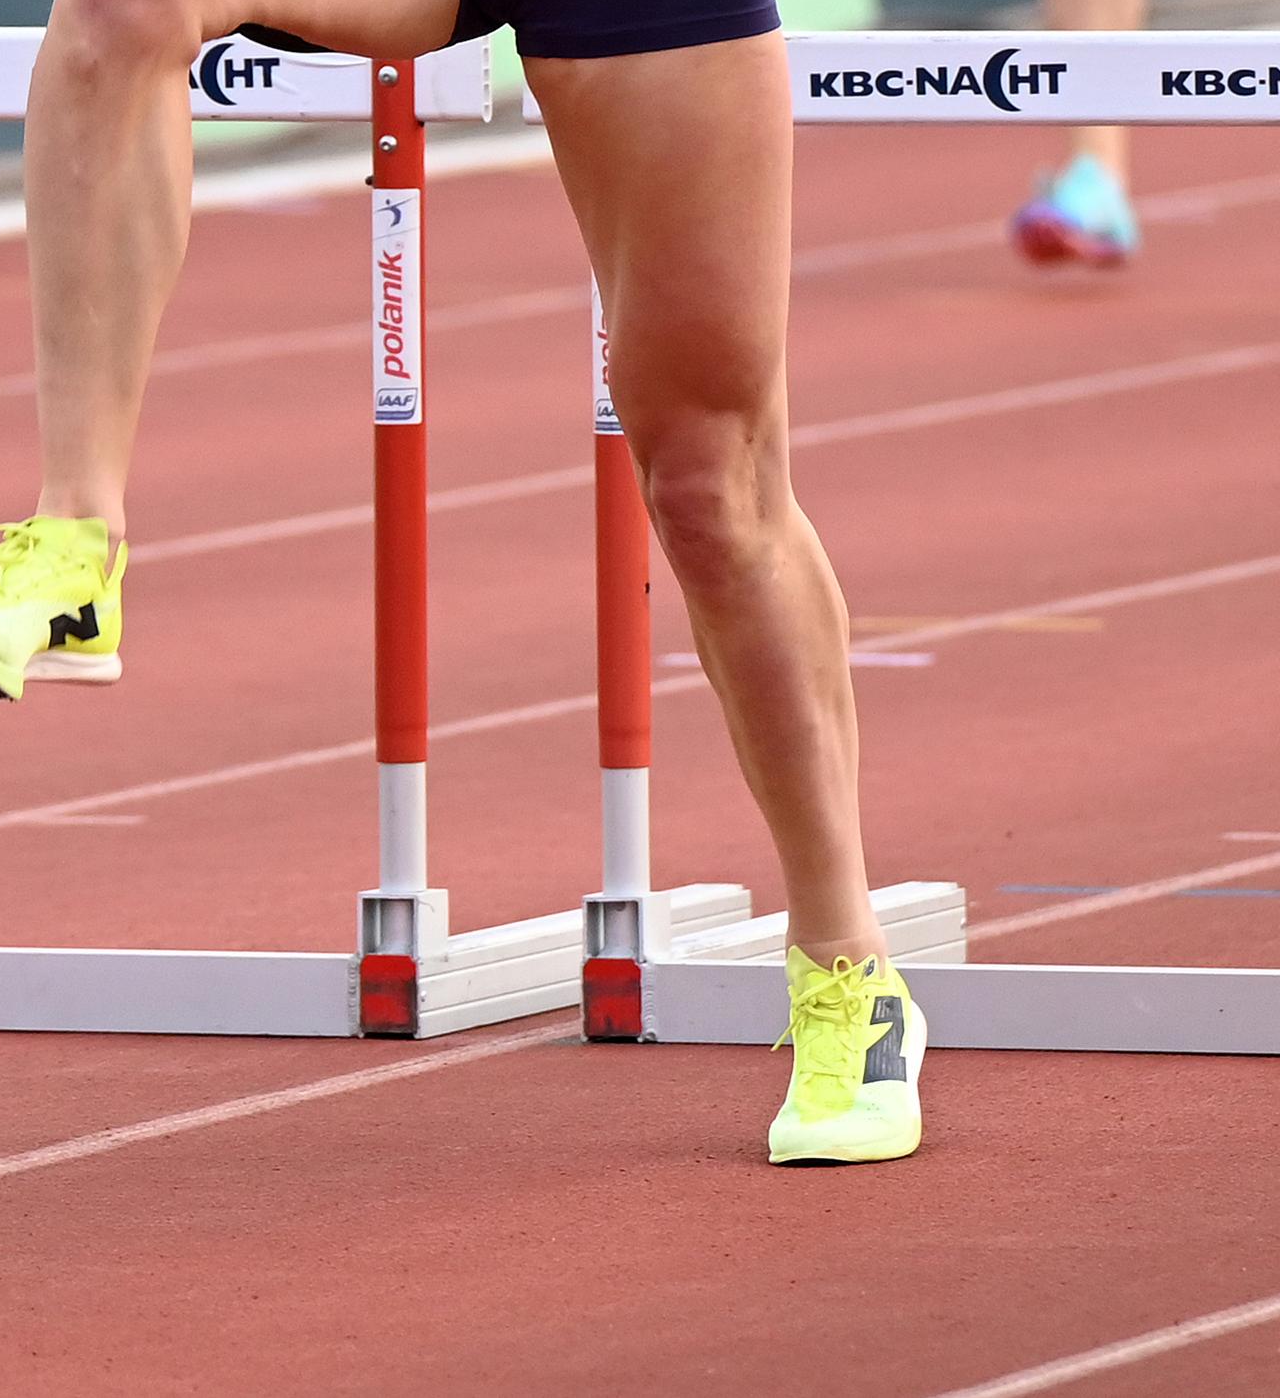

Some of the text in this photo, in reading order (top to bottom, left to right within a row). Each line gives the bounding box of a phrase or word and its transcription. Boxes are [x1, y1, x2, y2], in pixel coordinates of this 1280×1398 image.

[377, 249, 411, 380] polanik
[377, 393, 415, 408] IAAF
[597, 405, 618, 418] IAA
